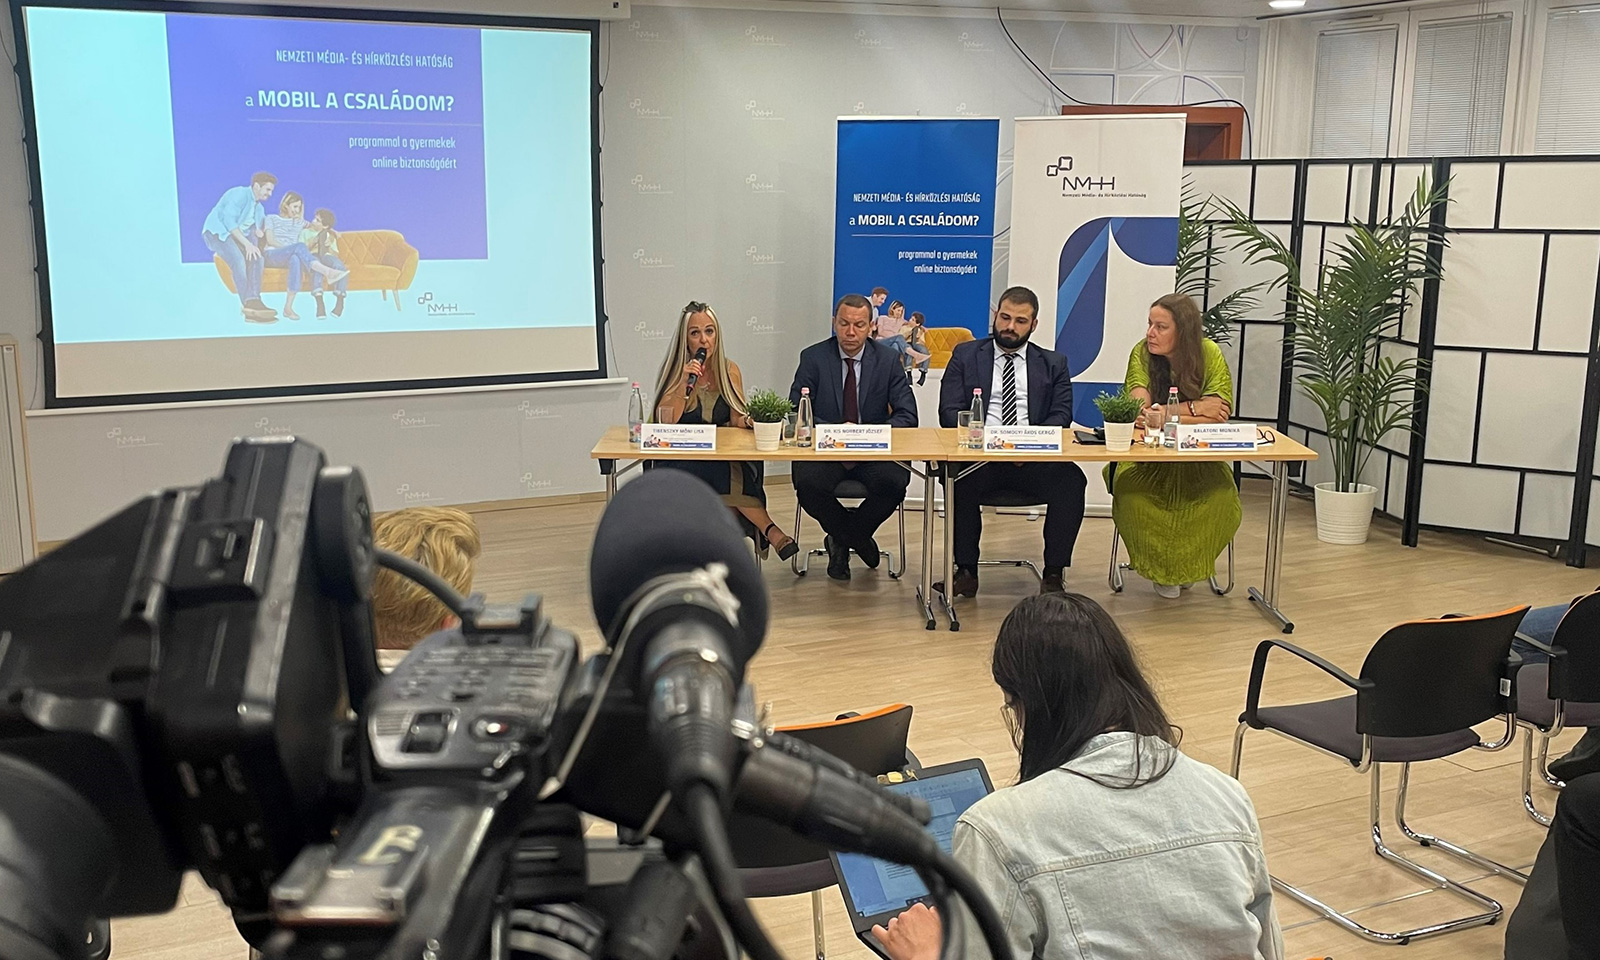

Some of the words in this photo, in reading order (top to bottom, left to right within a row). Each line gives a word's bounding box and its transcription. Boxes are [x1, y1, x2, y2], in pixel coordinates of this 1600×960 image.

[276, 50, 314, 63] NEMZETI
[317, 50, 348, 64] MÉDIA-
[352, 51, 362, 65] ÉS
[365, 52, 413, 66] HÍRKÖZLÉSI
[416, 54, 454, 68] HATÓSÁG
[245, 96, 254, 107] a
[258, 90, 320, 108] MOBIL
[326, 92, 338, 109] A
[344, 89, 454, 112] CSALÁDOM?
[349, 136, 400, 150] programmal
[409, 136, 456, 150] gyermekek
[372, 156, 398, 169] online
[400, 156, 457, 171] biztonságáért
[854, 193, 879, 202] NEMZETI
[881, 192, 904, 202] MÉDIA-
[906, 192, 913, 202] ÉS
[915, 192, 950, 202] HÍRKÖZLÉSI
[952, 192, 980, 203] HATÓSÁG
[849, 217, 856, 226] a
[858, 215, 895, 226] MOBIL
[898, 215, 906, 226] A
[908, 212, 979, 226] CSALÁDOM?
[898, 250, 935, 260] programmal
[942, 250, 977, 260] gyermekek
[914, 264, 933, 273] online
[934, 264, 977, 275] biztonságáért
